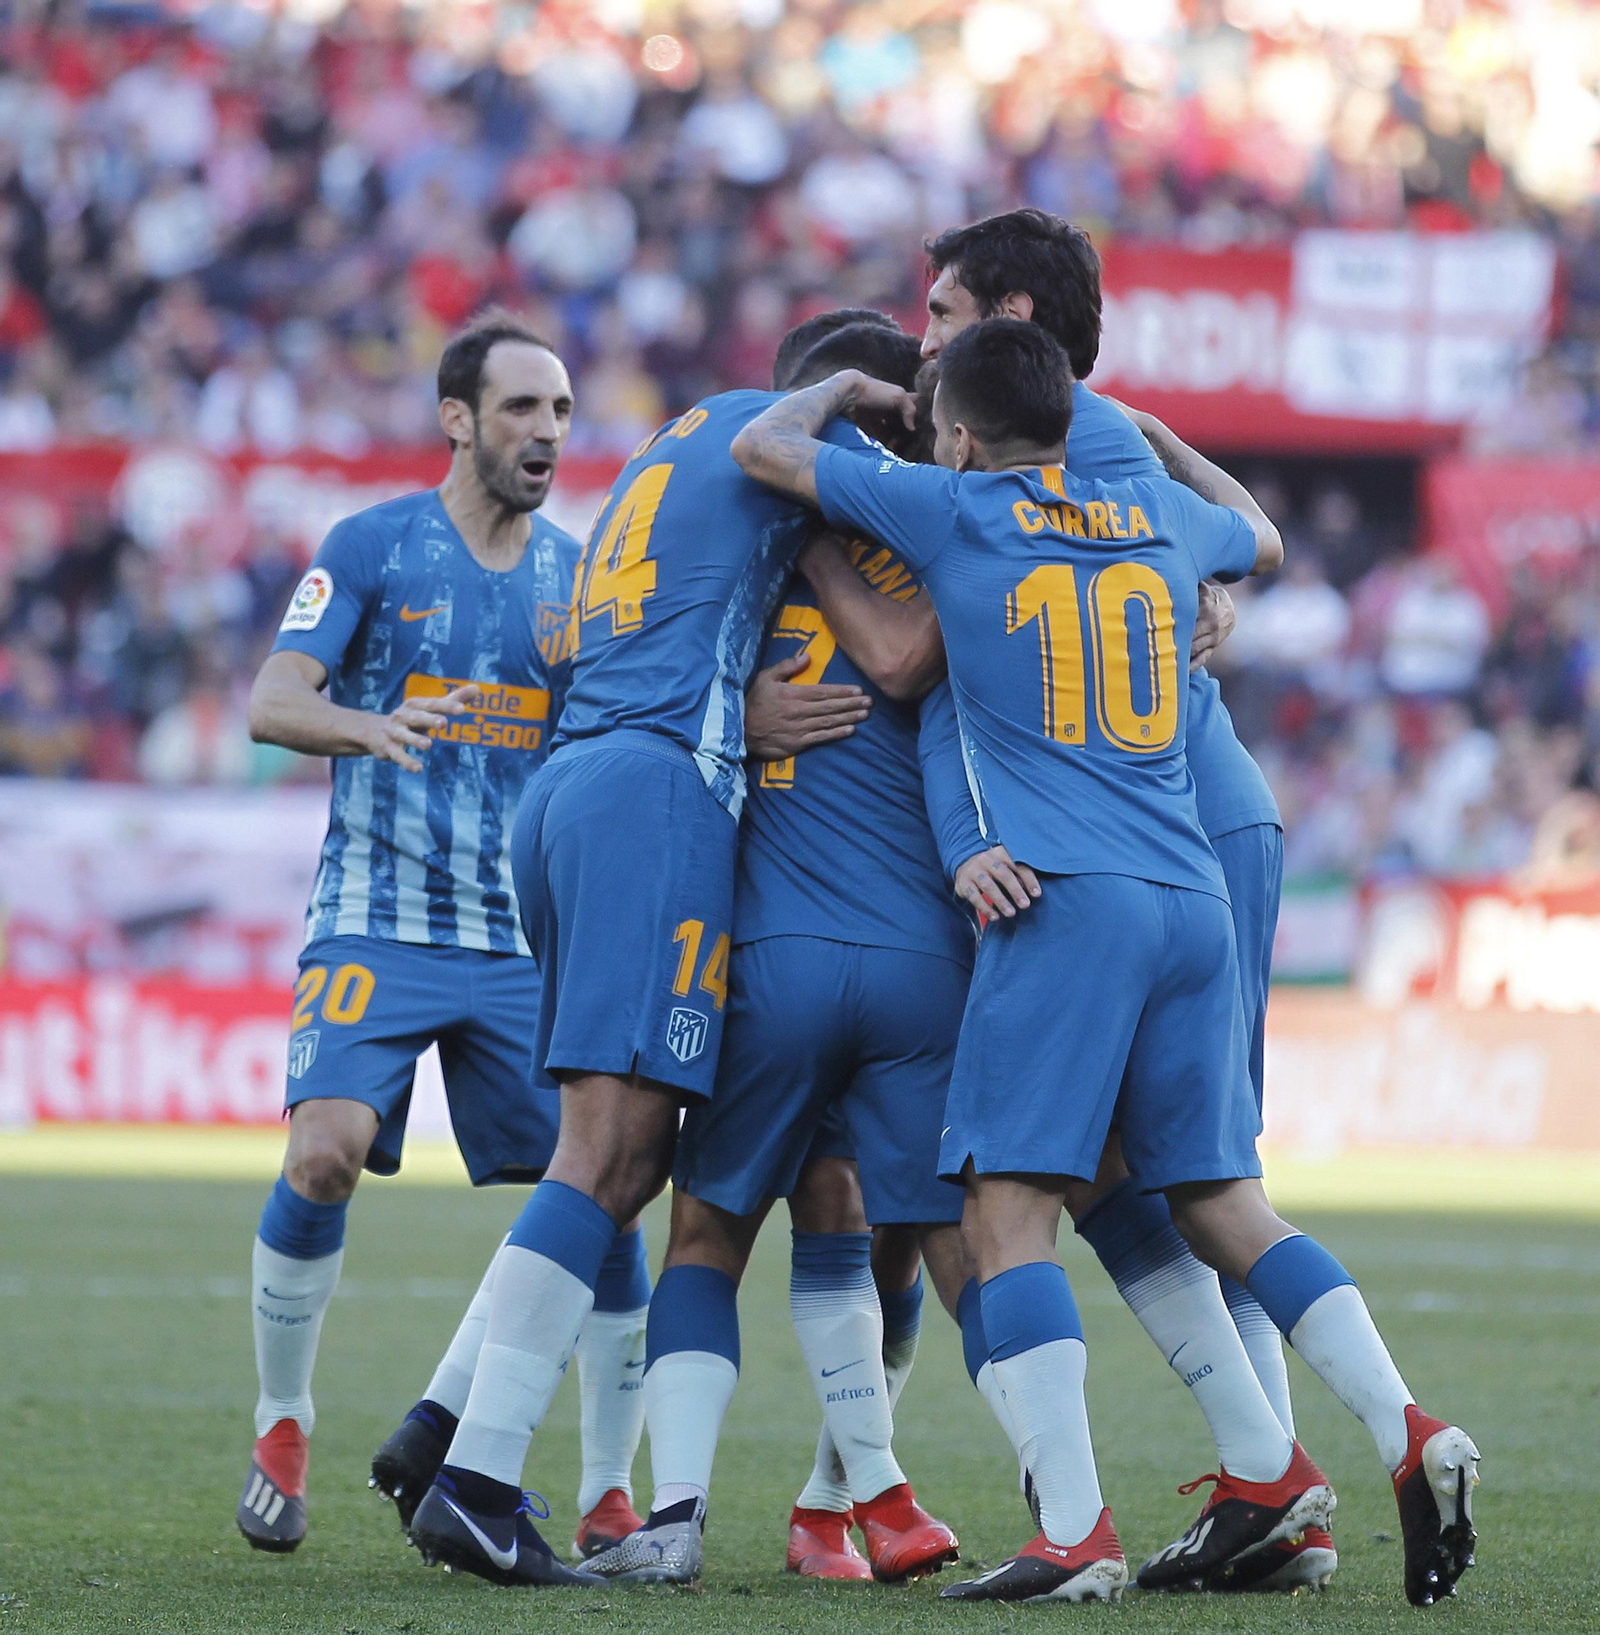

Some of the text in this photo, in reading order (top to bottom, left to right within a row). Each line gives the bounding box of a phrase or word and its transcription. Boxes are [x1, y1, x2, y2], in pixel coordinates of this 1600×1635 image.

[1012, 500, 1154, 539] CORREA
[1006, 561, 1178, 754] 10
[443, 682, 521, 714] Tade
[760, 605, 837, 789] 7
[427, 718, 541, 750] us500
[671, 918, 731, 1013] 14
[291, 962, 377, 1034] 20
[827, 1387, 875, 1403] ATLÉTICO
